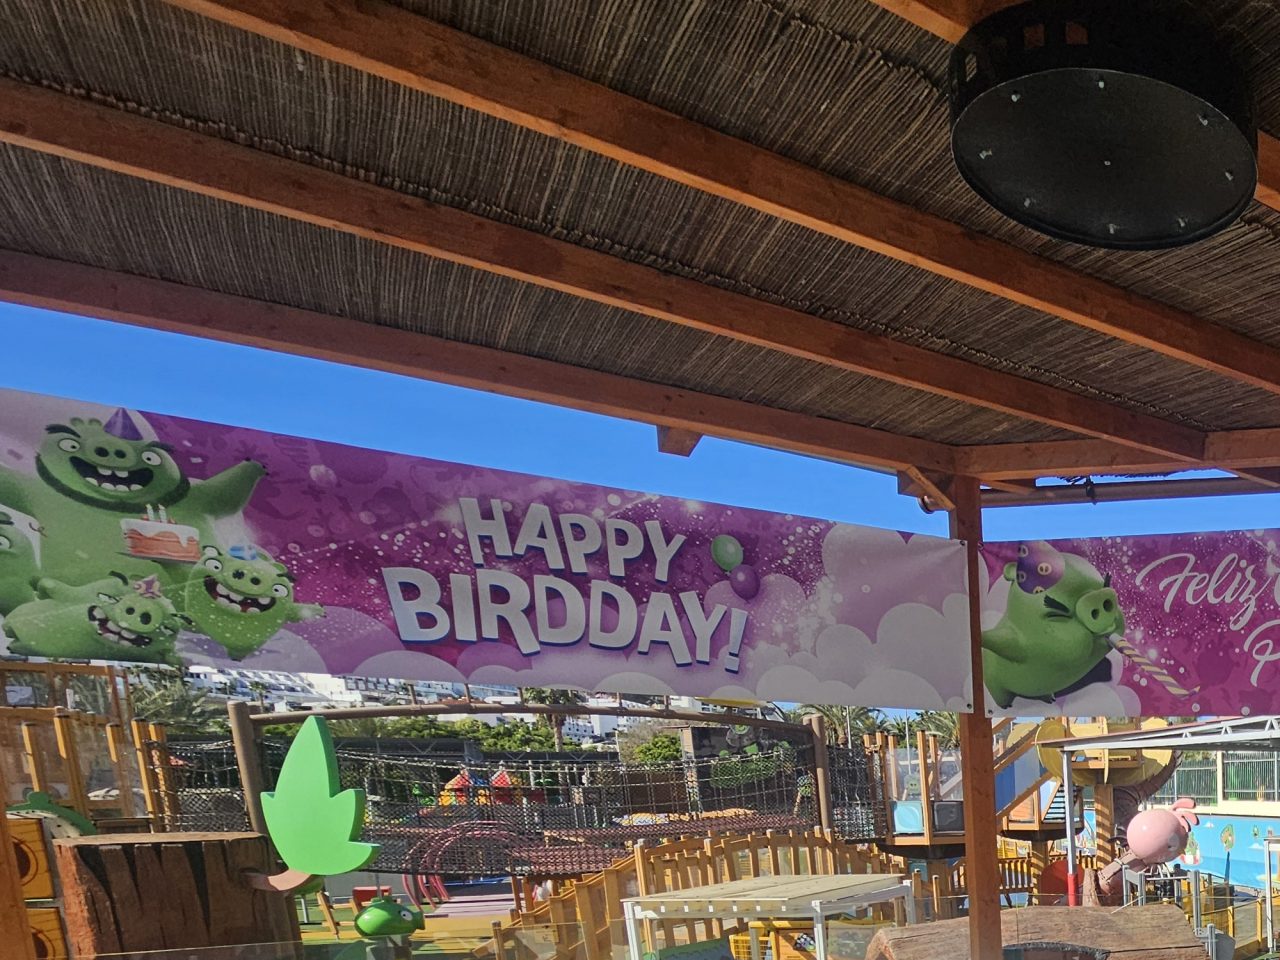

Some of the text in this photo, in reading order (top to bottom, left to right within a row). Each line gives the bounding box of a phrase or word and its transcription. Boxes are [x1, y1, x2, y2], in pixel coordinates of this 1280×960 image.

[459, 498, 686, 582] HAPPY
[382, 567, 748, 673] BIRDDAY!
[1135, 552, 1273, 631] Feliz
